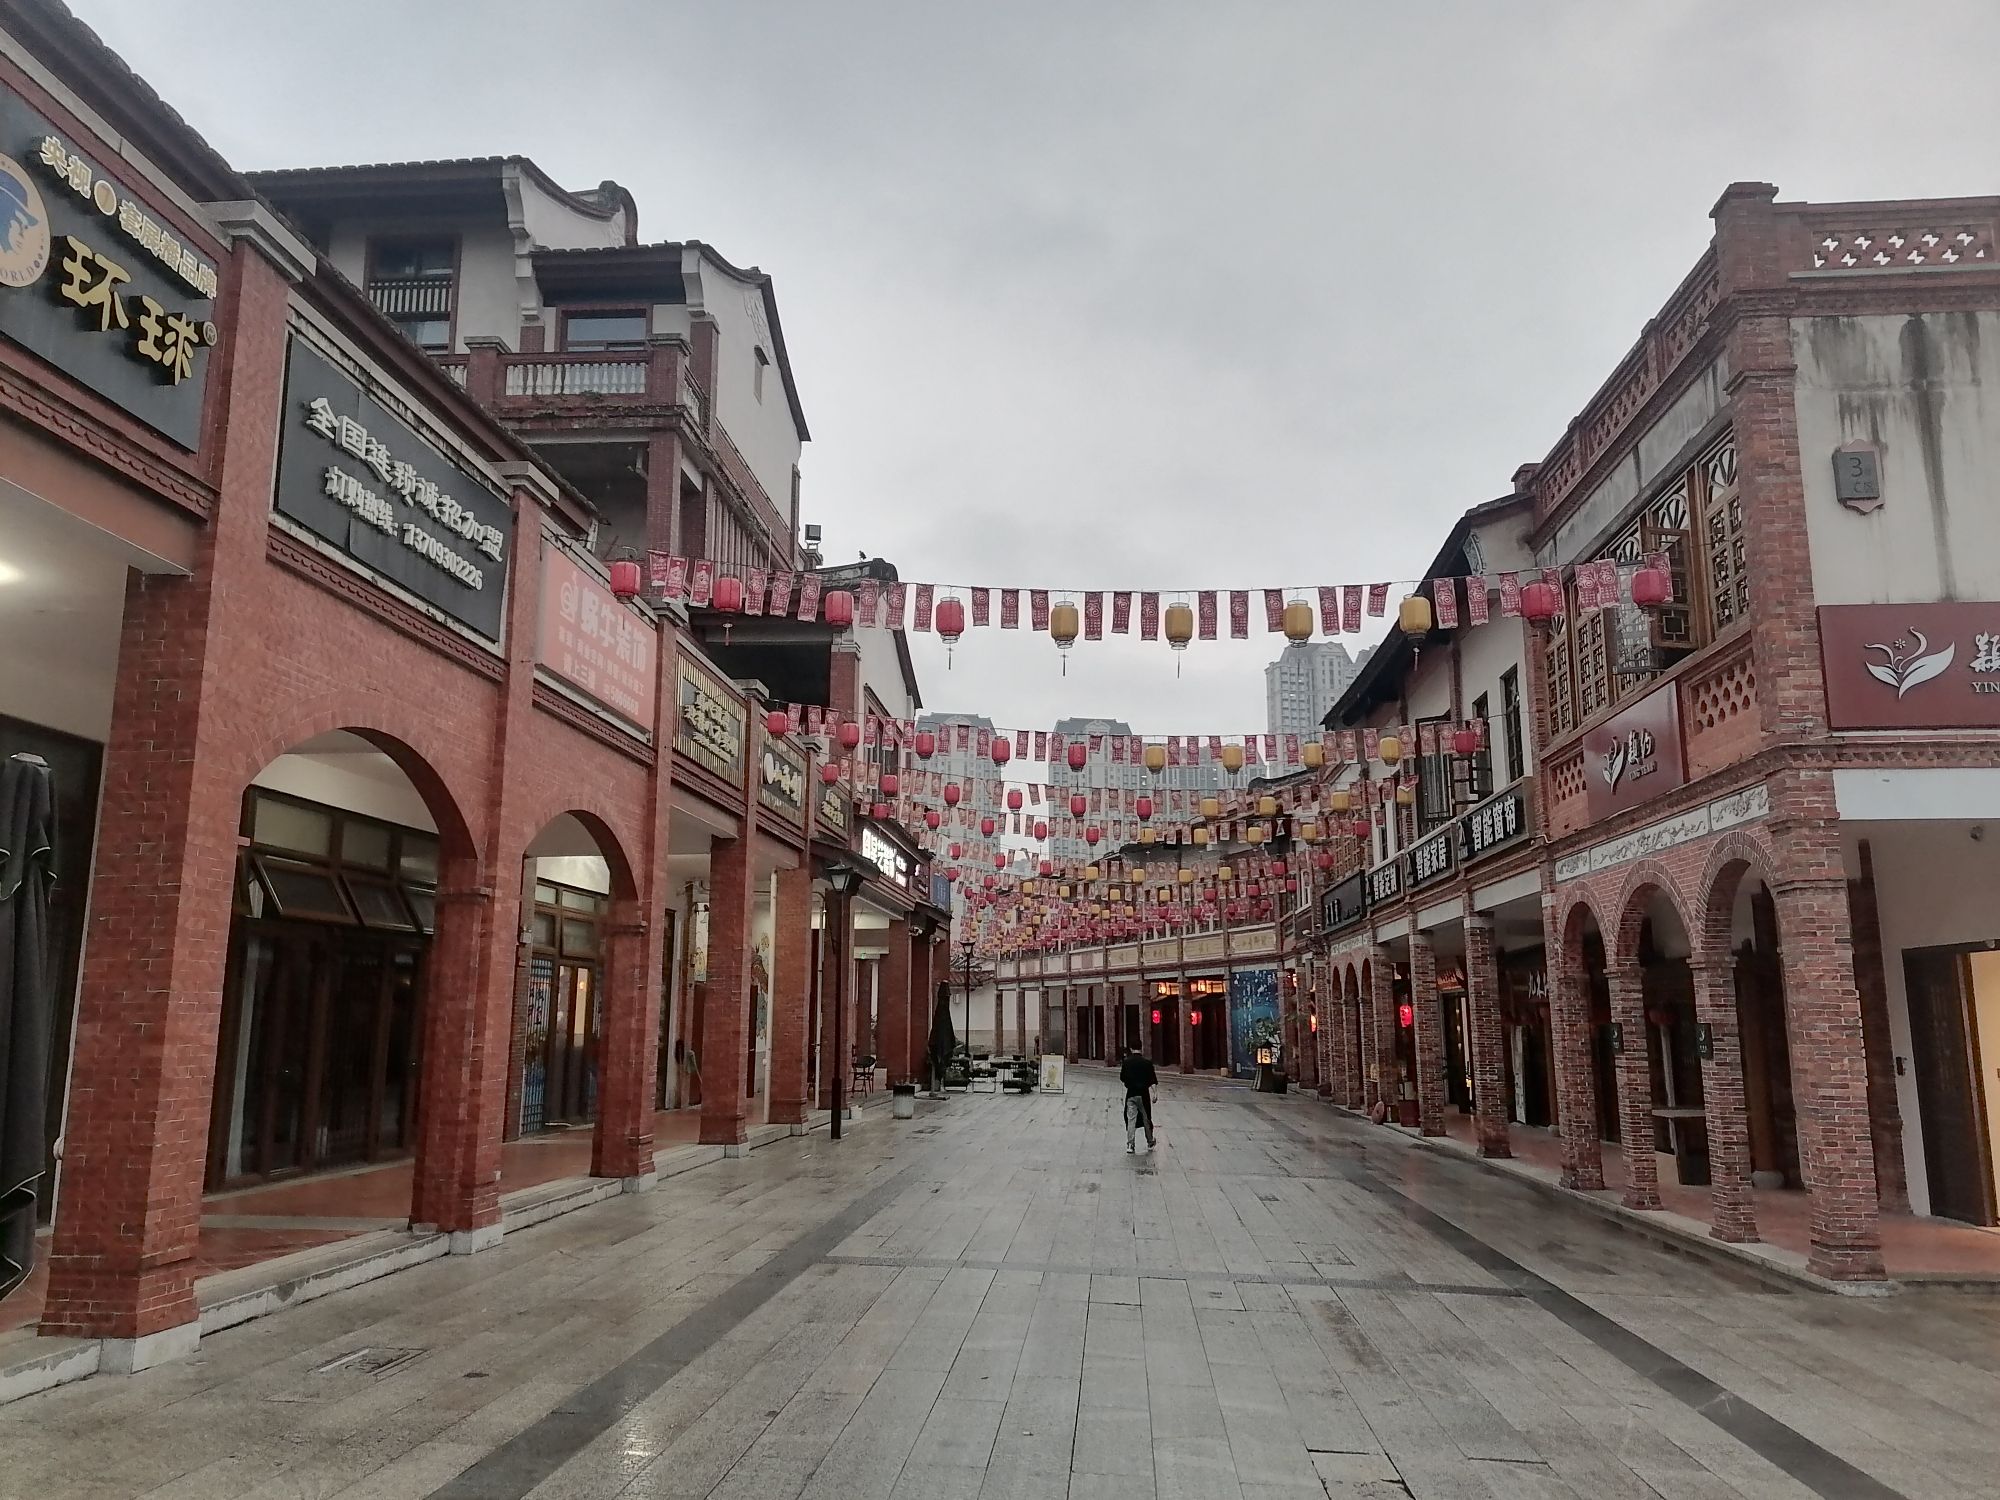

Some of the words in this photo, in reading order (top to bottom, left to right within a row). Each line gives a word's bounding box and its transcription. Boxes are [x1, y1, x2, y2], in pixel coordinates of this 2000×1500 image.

[61, 235, 200, 385] 环球
[306, 397, 503, 562] 全国连锁诚招加盟
[1415, 835, 1447, 881] 智能家居
[1472, 796, 1516, 851] 智能窗帘
